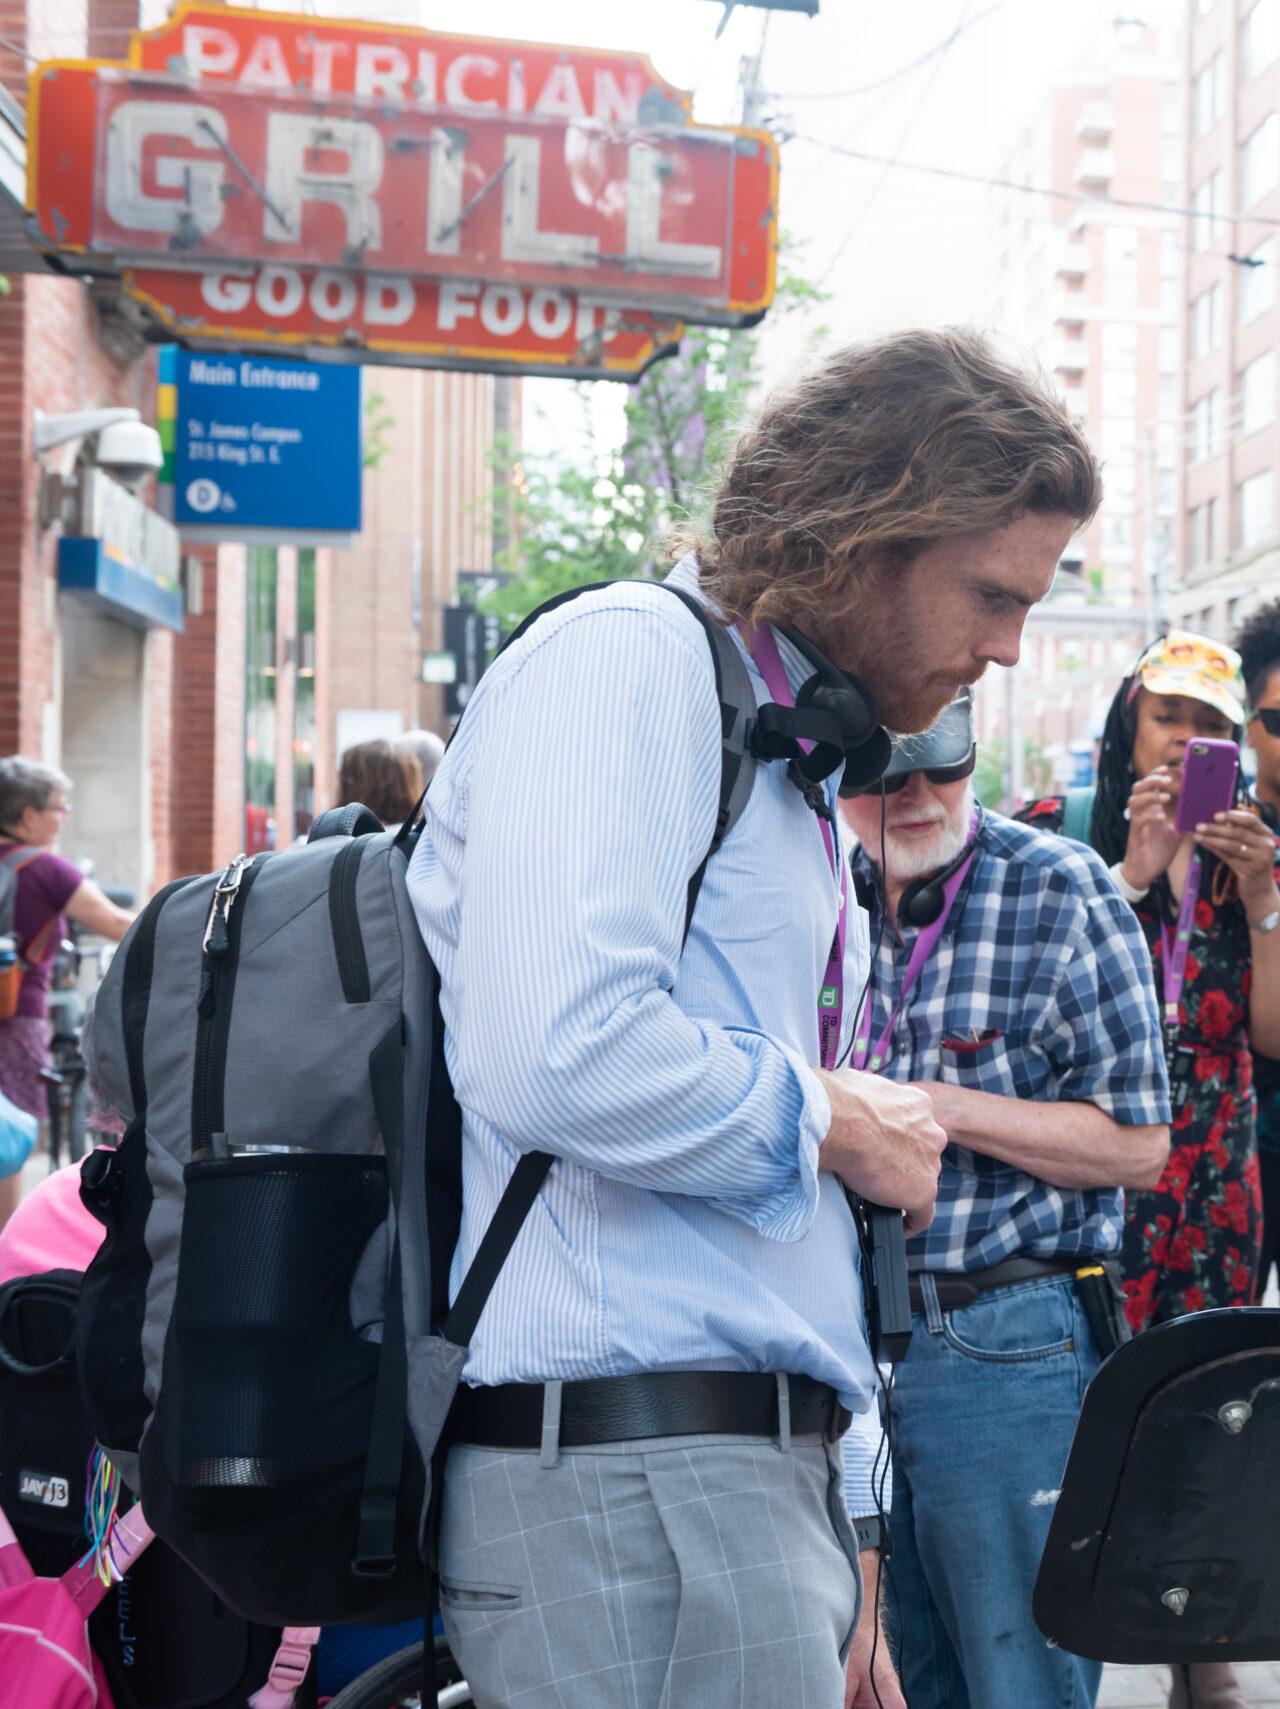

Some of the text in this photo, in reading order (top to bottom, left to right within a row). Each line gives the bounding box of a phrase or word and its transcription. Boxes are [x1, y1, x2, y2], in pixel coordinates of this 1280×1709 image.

[183, 24, 642, 127] PATRICIAN
[104, 101, 723, 279] GRILL
[201, 267, 619, 343] GOOD FOOD
[188, 360, 320, 391] Main Entrance
[209, 421, 249, 440] James
[251, 422, 303, 443] Campus
[217, 443, 247, 466] King
[821, 988, 835, 1006] TD
[830, 1015, 838, 1026] TD
[820, 1014, 830, 1068] COMMITMEN
[20, 1477, 66, 1502] JAY J3
